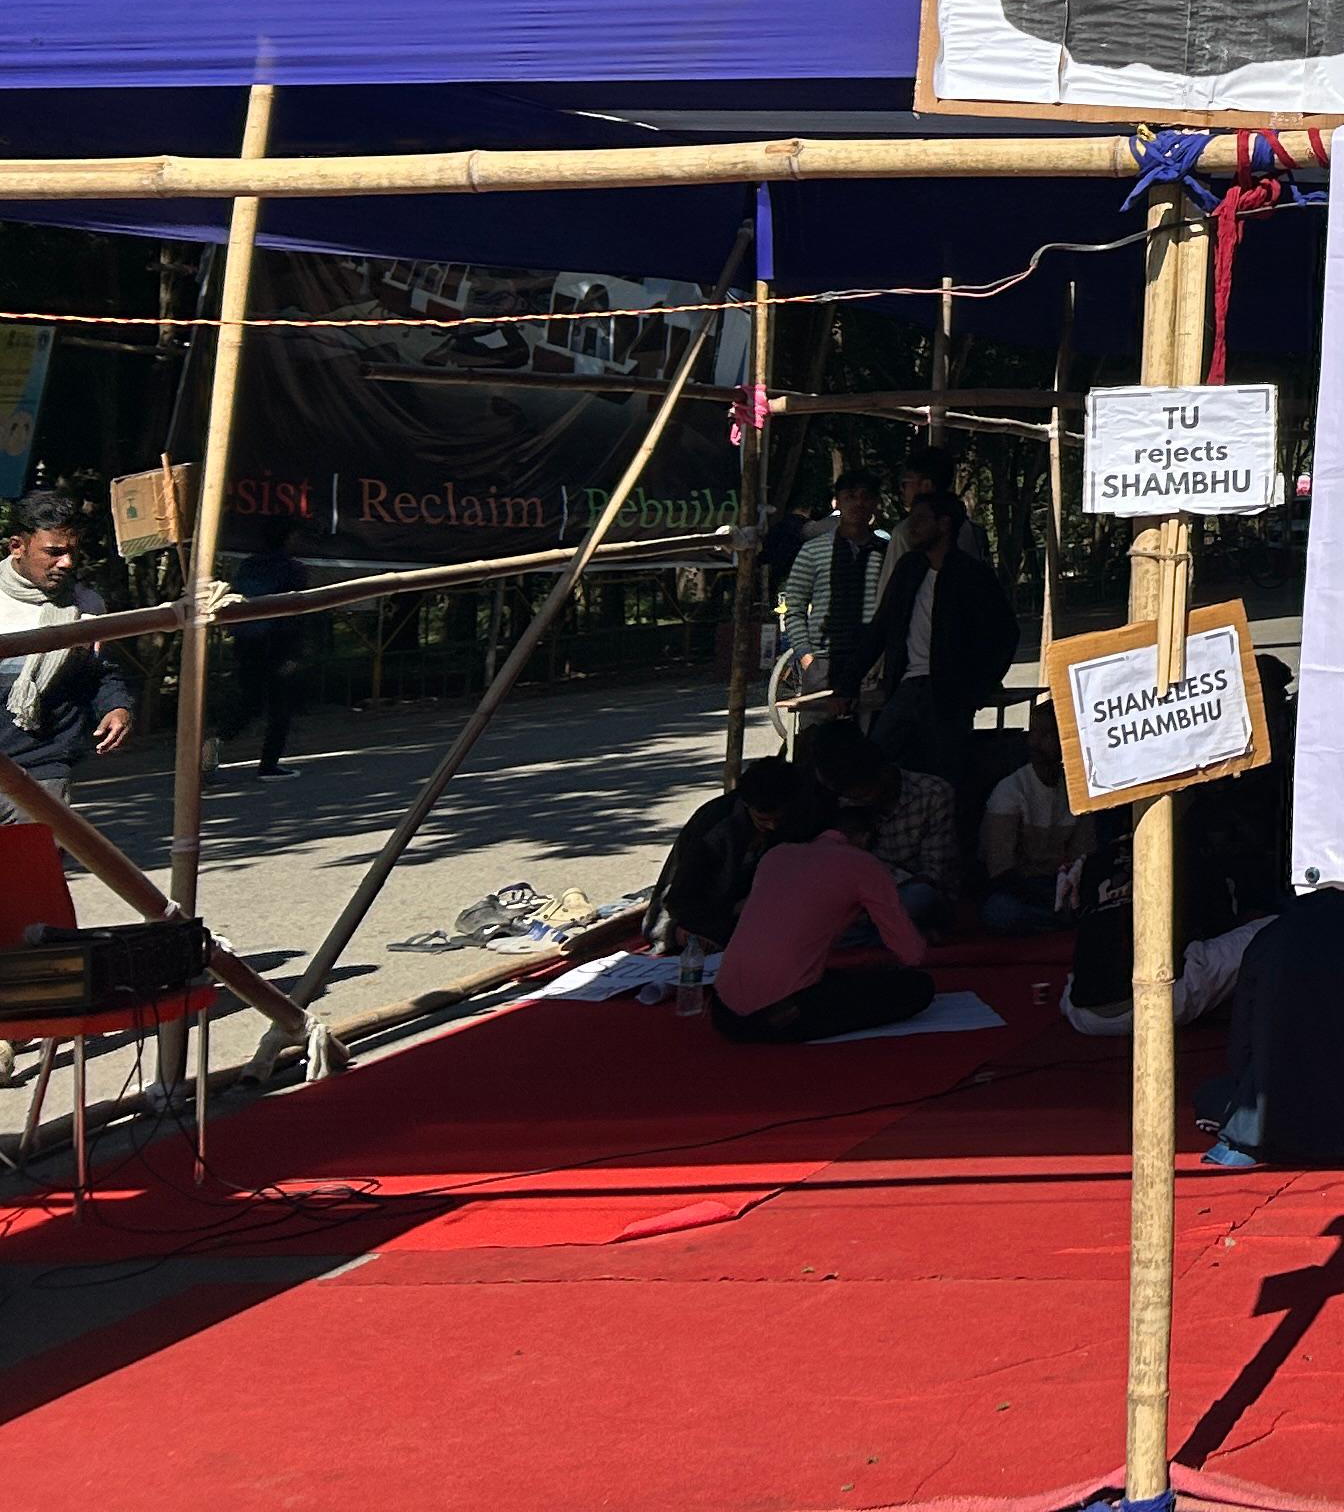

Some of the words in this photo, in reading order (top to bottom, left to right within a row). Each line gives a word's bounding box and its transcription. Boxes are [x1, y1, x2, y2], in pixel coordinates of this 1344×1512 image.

[1162, 406, 1201, 430] TU
[1134, 439, 1229, 471] rejects
[1101, 469, 1252, 499] SHAMBHU
[358, 478, 545, 529] Reclaim
[1107, 698, 1223, 749] SHAMBHU
